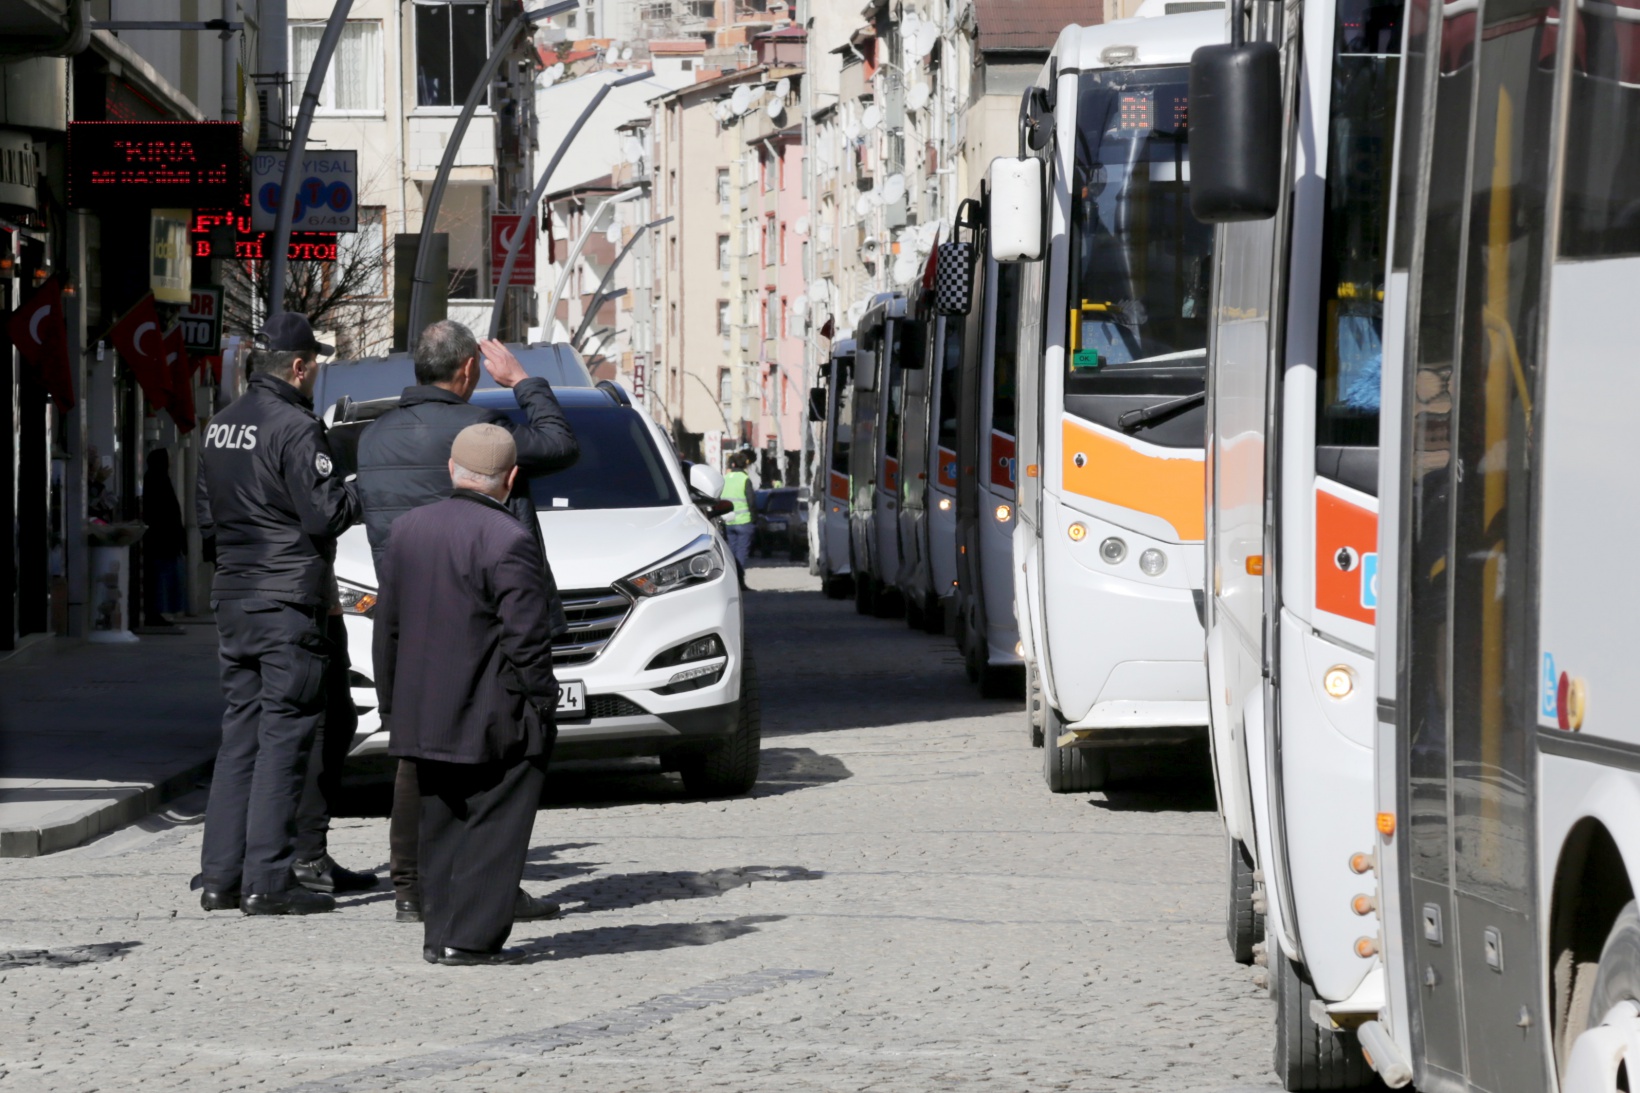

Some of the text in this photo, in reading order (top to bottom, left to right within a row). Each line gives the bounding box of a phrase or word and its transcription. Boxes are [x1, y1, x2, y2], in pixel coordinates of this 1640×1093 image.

[278, 160, 352, 173] SYISAL
[308, 215, 350, 226] 6/49
[204, 423, 258, 450] POLİS
